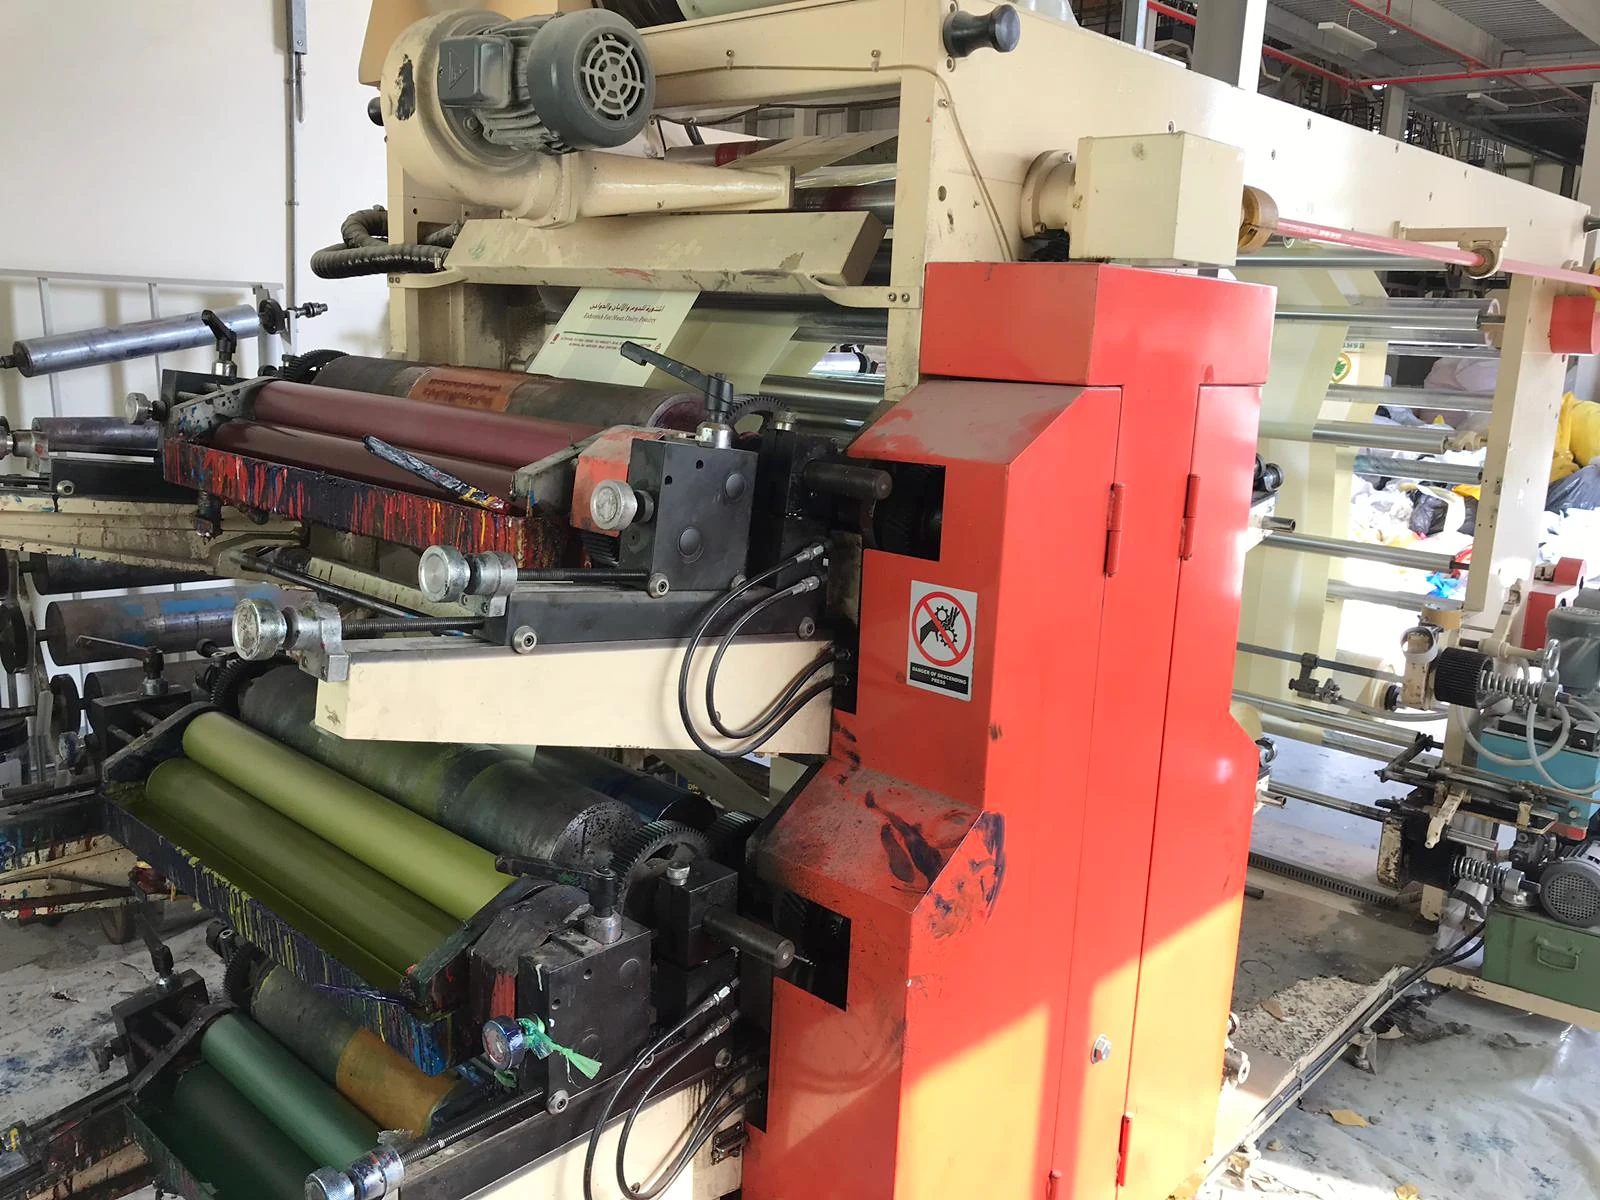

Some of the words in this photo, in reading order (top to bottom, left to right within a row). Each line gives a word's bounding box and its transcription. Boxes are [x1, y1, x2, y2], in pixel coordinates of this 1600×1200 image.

[912, 666, 930, 675] DANGER
[937, 672, 967, 684] DESCENDING
[931, 677, 946, 685] PRESS
